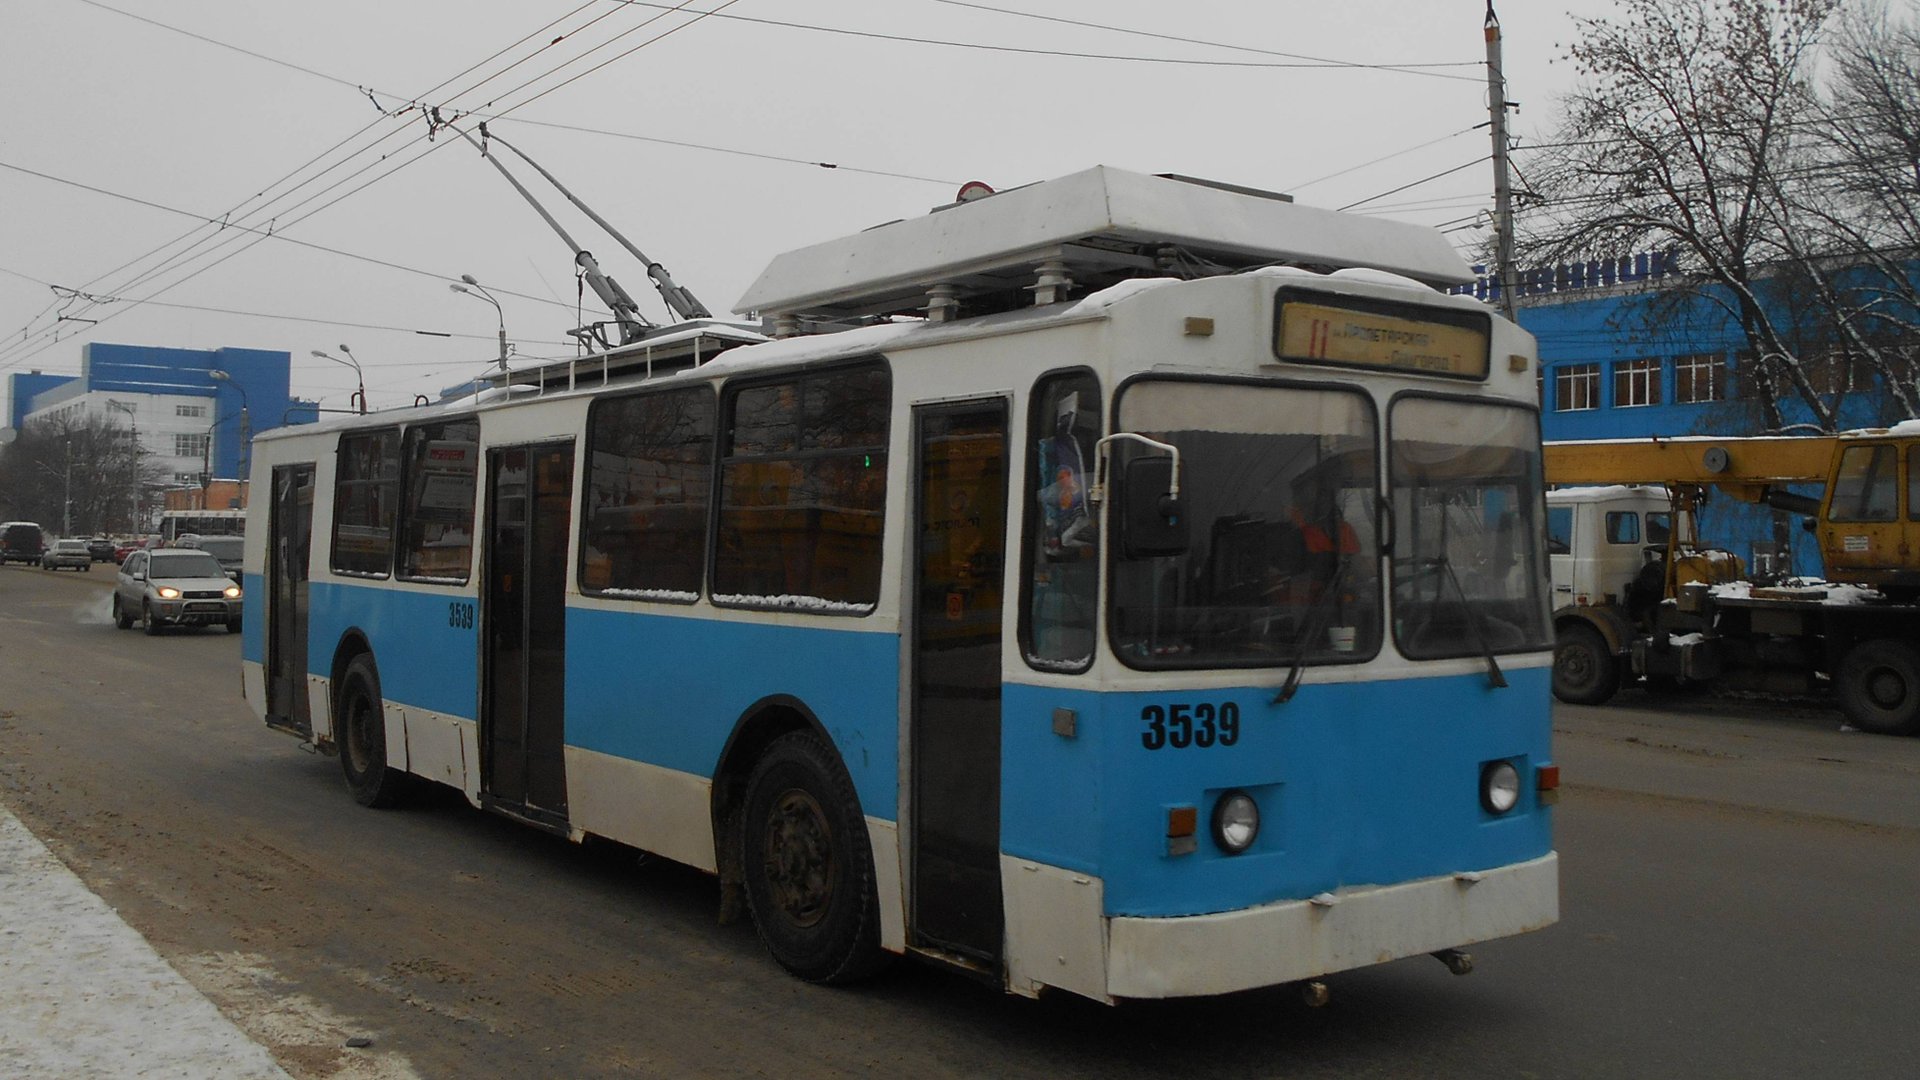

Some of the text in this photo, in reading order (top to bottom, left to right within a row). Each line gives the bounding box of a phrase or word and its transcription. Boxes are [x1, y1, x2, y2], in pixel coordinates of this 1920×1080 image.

[1309, 319, 1330, 359] 11
[448, 602, 473, 630] 3539
[1141, 702, 1239, 750] 3539
